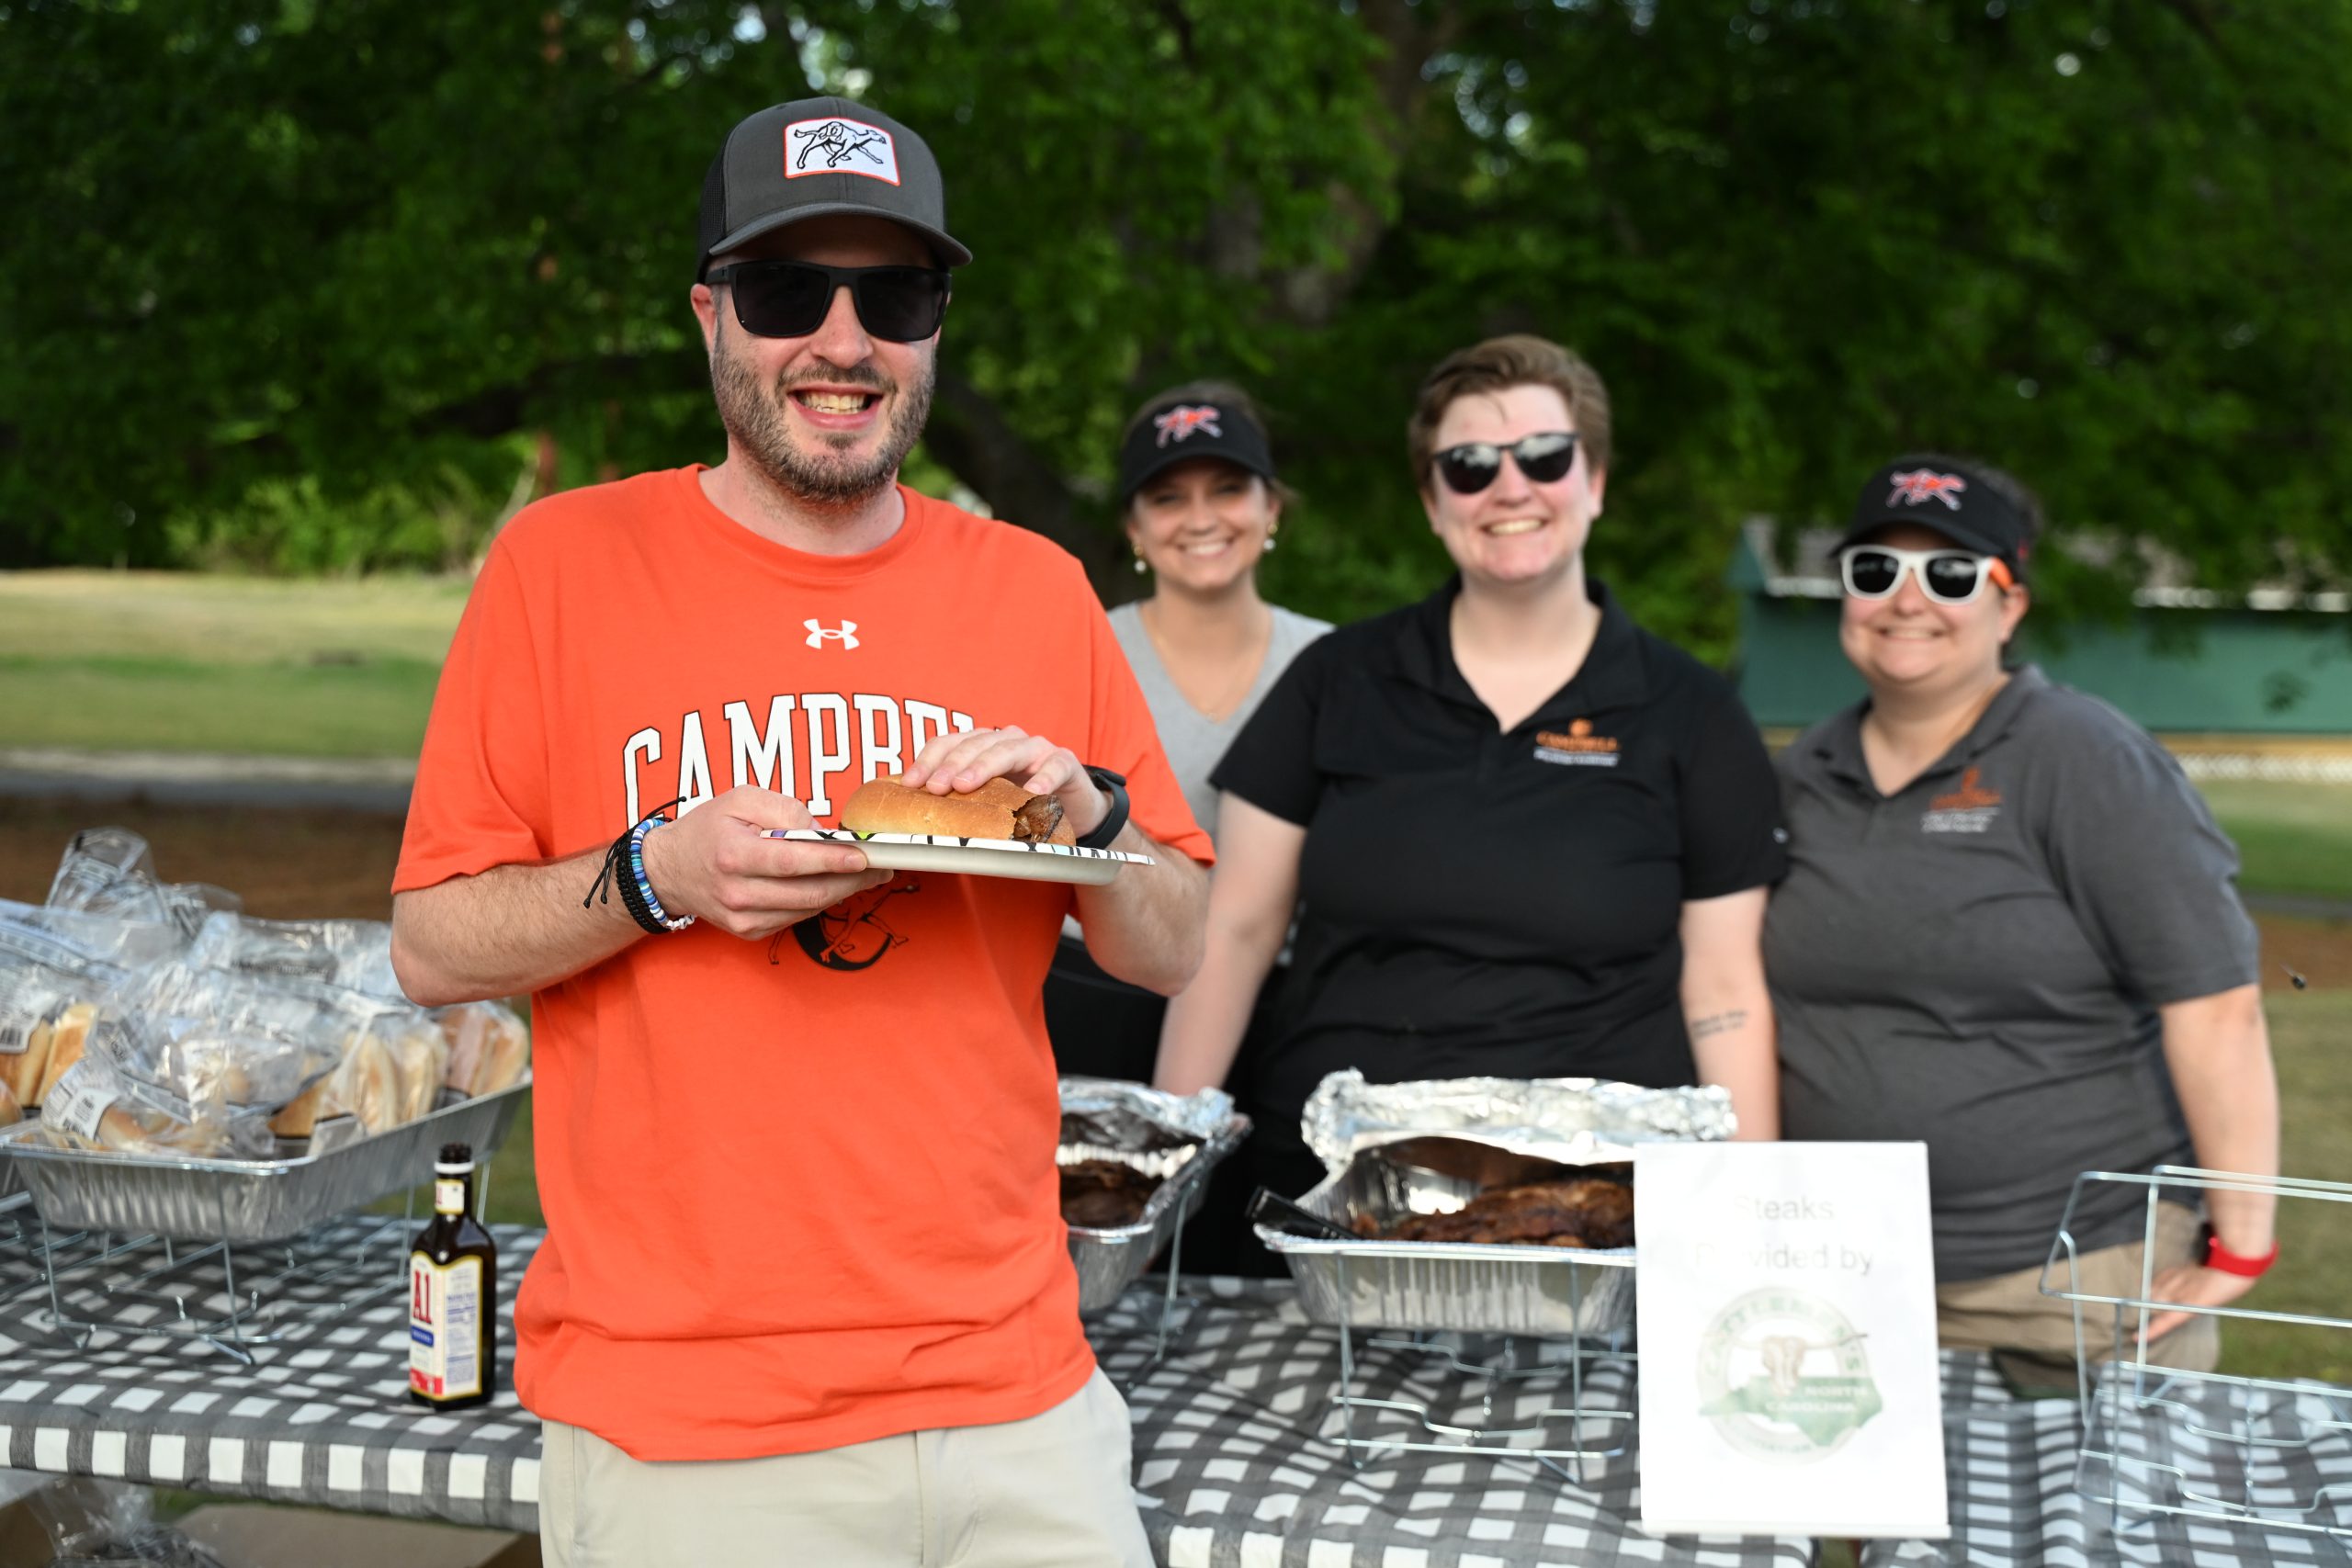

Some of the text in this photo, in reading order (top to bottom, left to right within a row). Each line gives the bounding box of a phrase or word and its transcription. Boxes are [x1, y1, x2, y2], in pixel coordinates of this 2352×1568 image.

[622, 693, 1002, 830] CAMPB
[1733, 1194, 1835, 1221] Steaks
[1695, 1243, 1875, 1277] Pvided by
[1804, 1385, 1870, 1397] NORTH
[1764, 1401, 1856, 1412] CAROLINA
